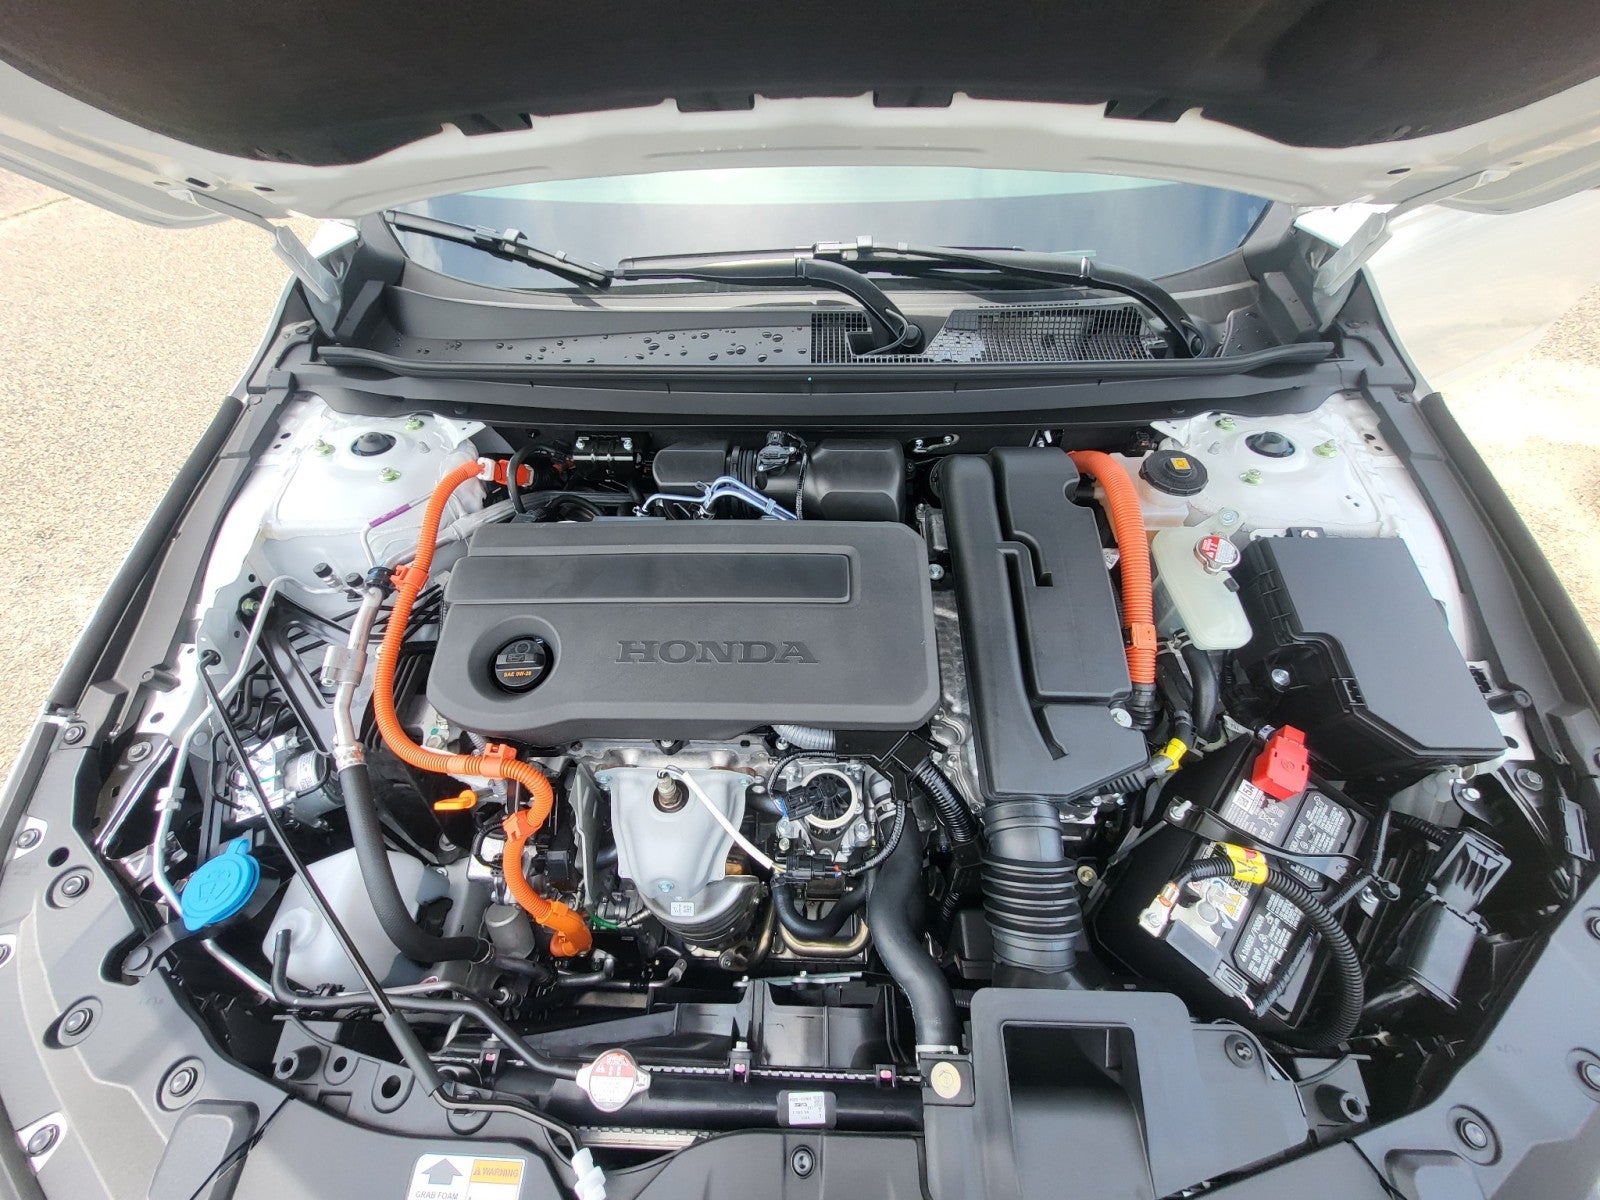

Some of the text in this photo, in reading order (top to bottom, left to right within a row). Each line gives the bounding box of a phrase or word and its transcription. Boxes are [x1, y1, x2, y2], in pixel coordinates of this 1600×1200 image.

[614, 639, 819, 665] HONDA
[482, 1168, 519, 1178] WARNING
[415, 1191, 459, 1200] GRAB FOAM
